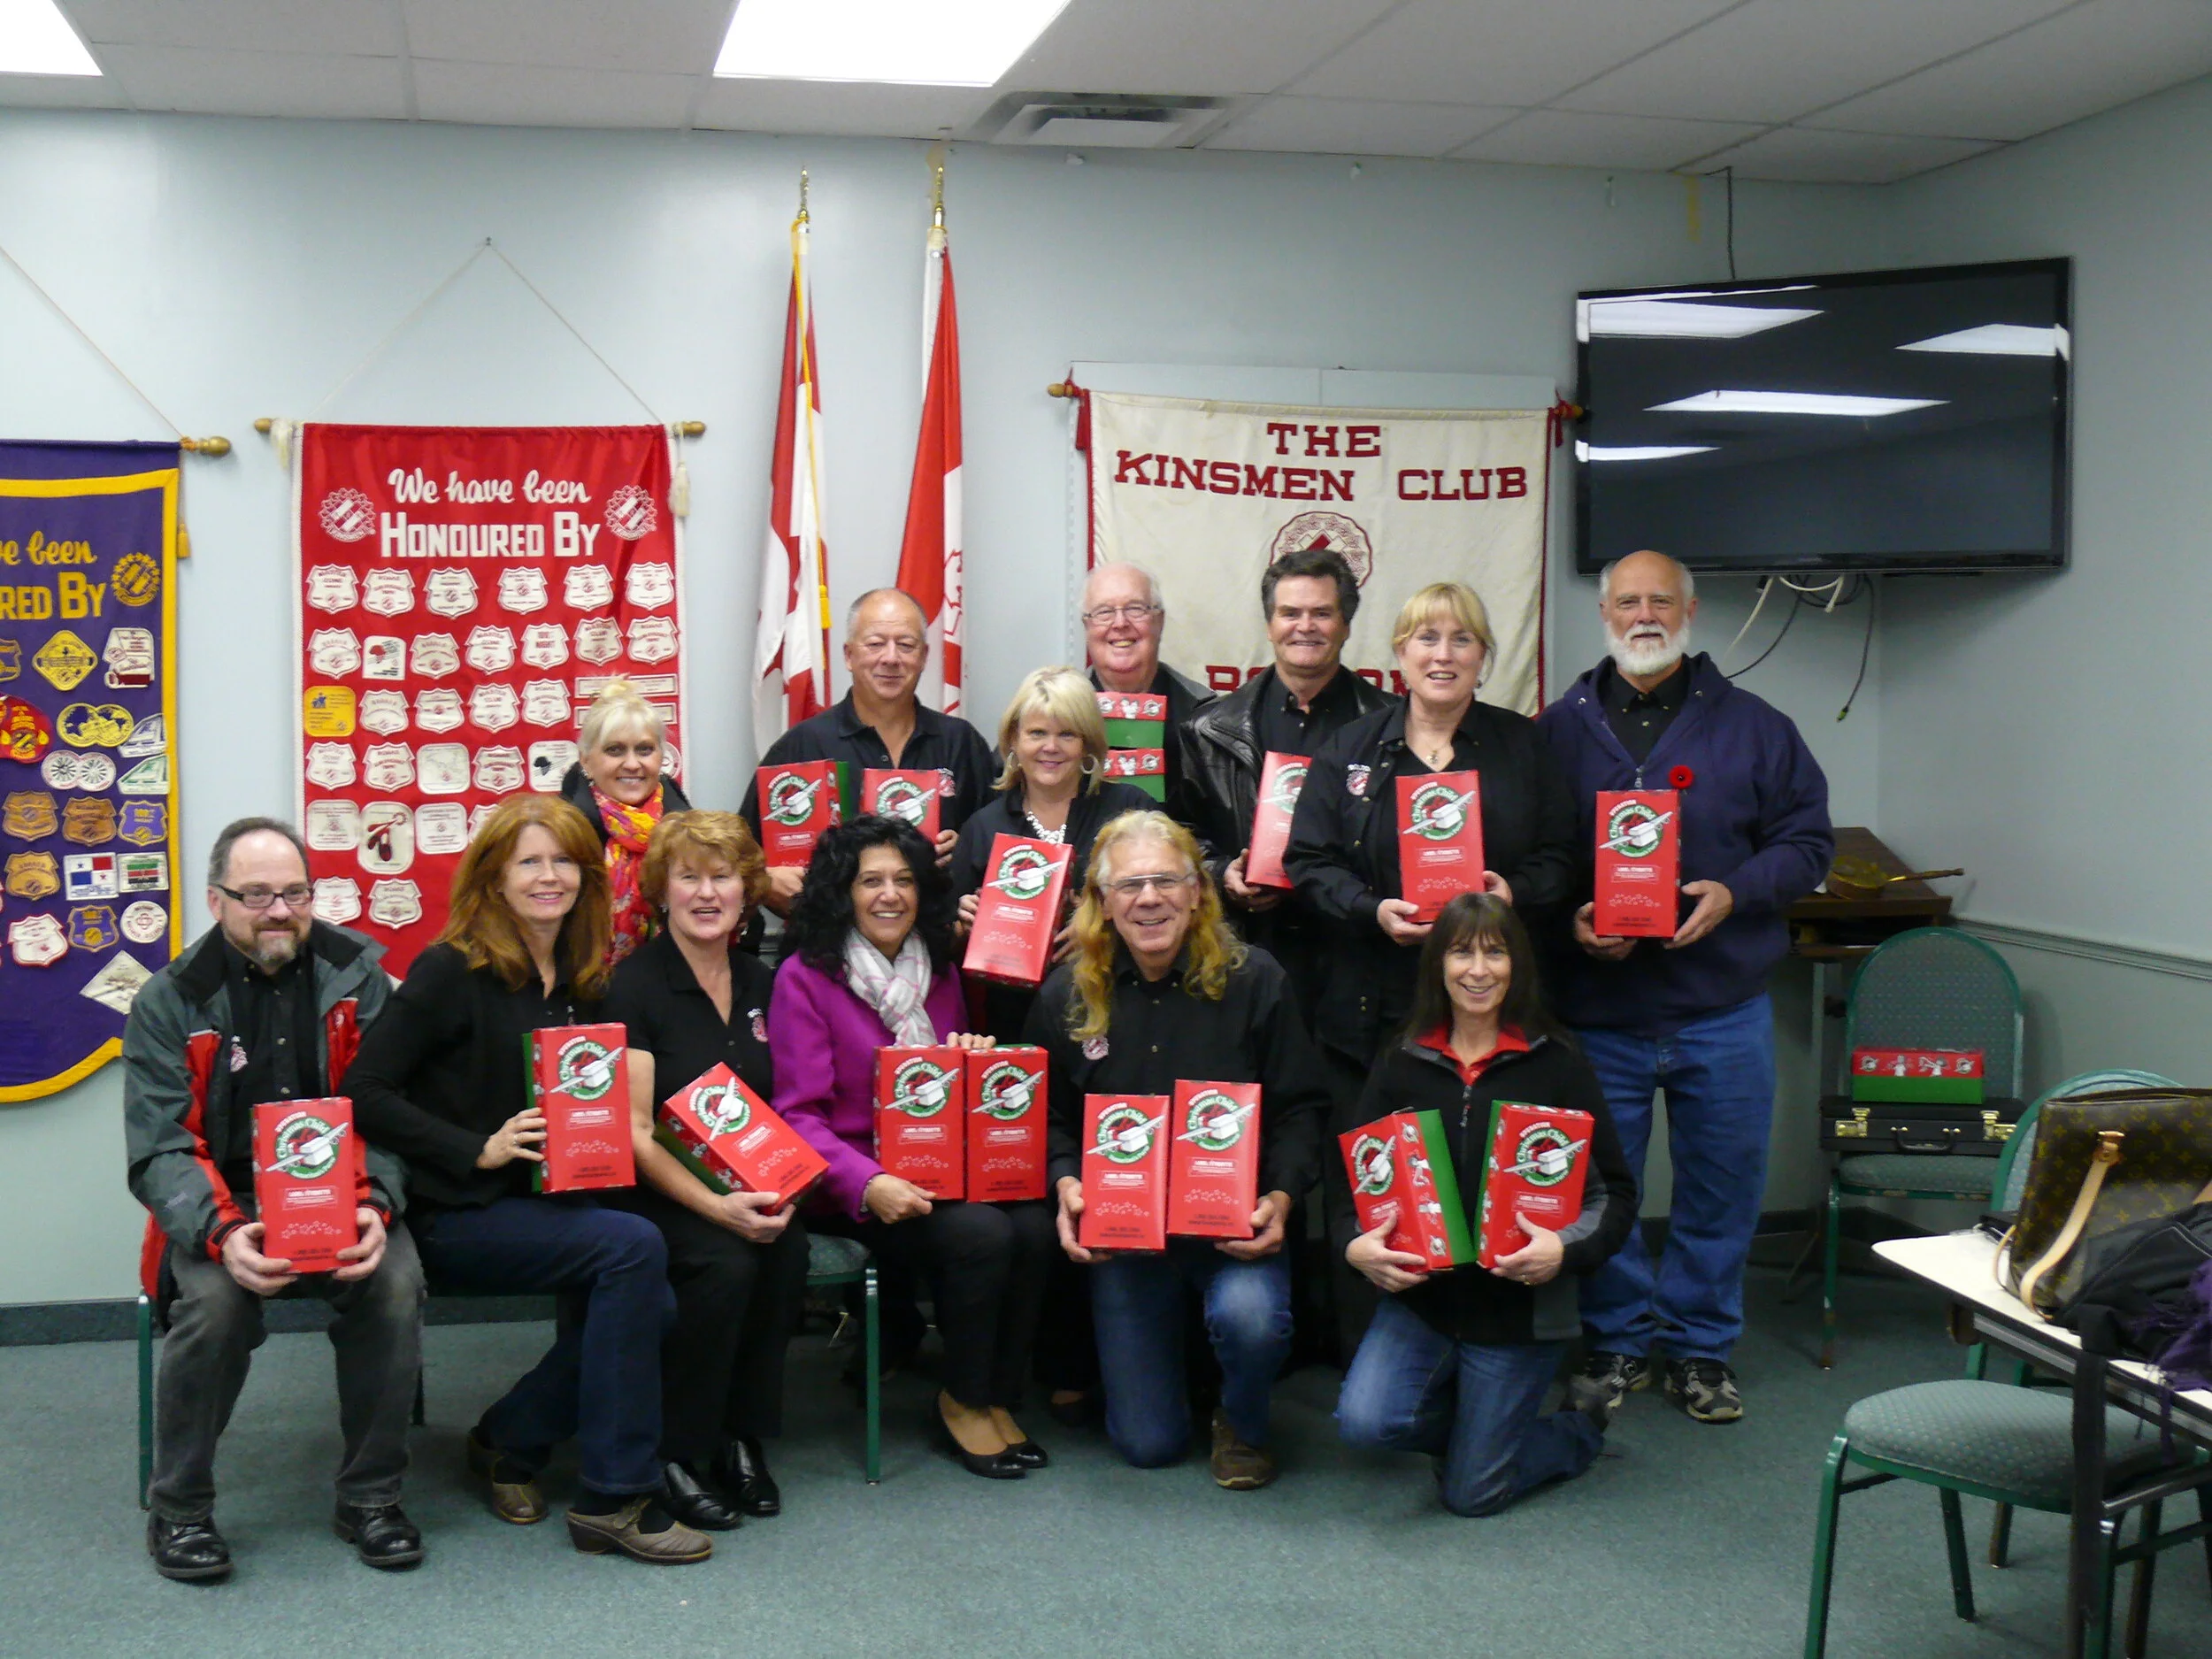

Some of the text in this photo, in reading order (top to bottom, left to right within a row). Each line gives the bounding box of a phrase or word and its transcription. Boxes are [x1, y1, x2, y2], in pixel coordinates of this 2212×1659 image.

[1267, 422, 1382, 458] THE
[388, 467, 592, 504] We have been
[1115, 449, 1527, 502] KINSMEN CLUB
[26, 530, 98, 565] been
